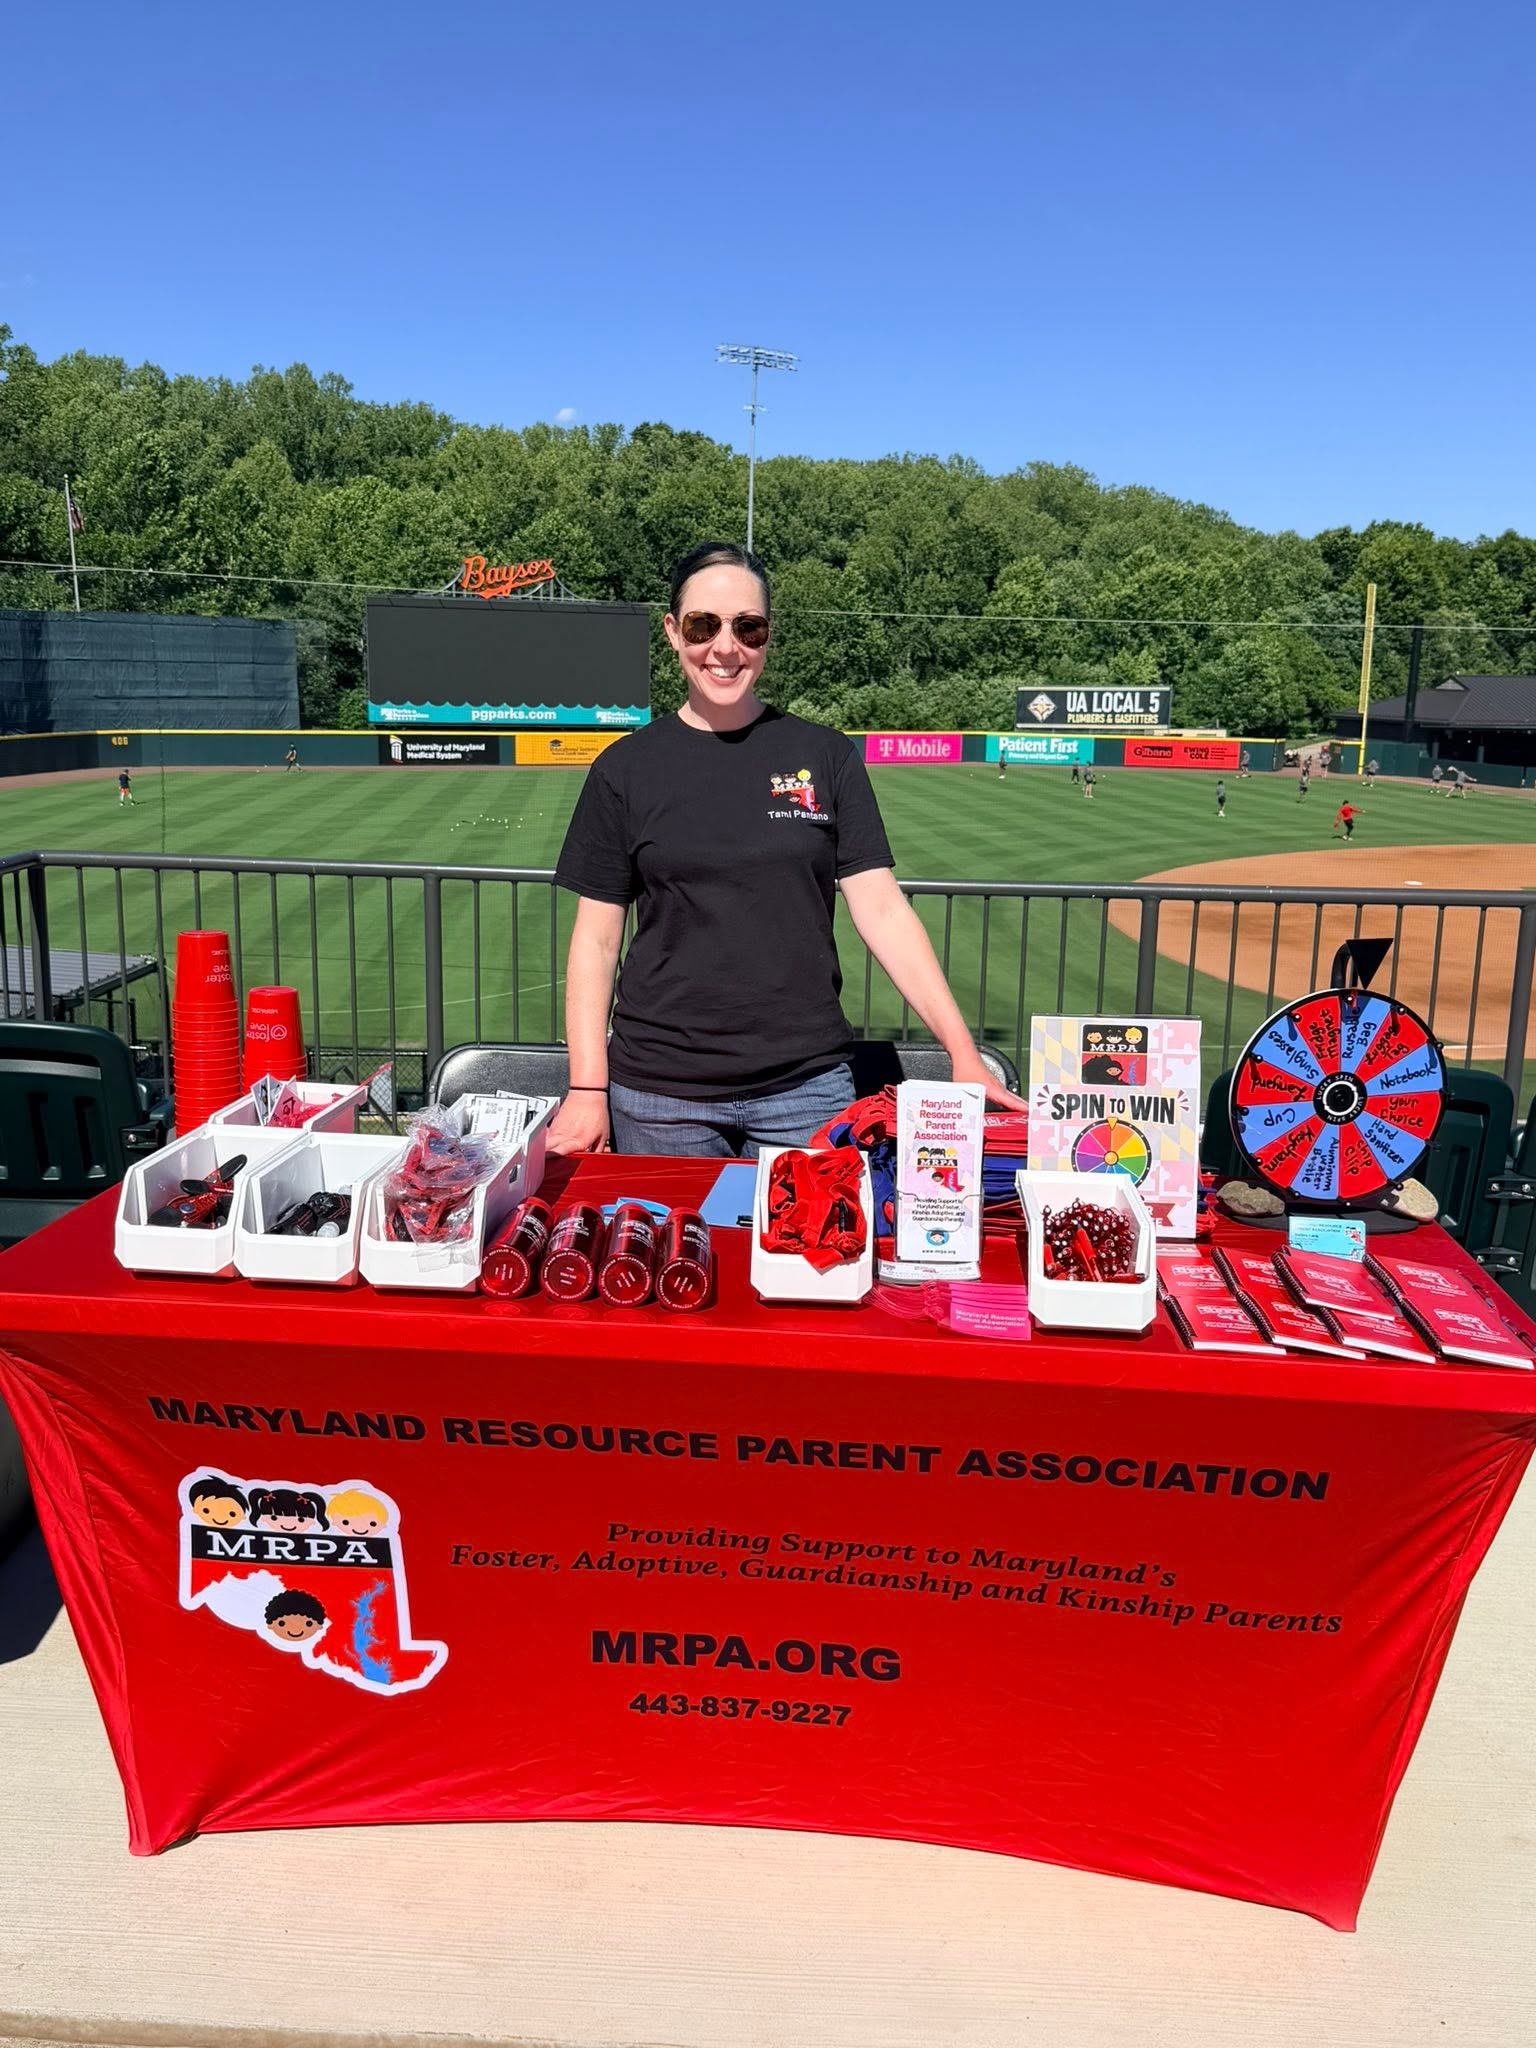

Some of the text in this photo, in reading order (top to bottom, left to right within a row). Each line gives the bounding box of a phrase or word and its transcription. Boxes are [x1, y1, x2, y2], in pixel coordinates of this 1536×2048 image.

[461, 555, 555, 599] Baysox
[1066, 692, 1160, 713] UA LOCAL 5
[471, 707, 556, 721] pgparks.com
[1067, 714, 1158, 723] PLUMBERS & GASFITTERS
[406, 743, 485, 752] University of Maryland
[880, 739, 951, 757] T Mobile
[1000, 737, 1078, 753] Patient First
[1134, 746, 1173, 758] Gilbane
[436, 752, 462, 760] System
[768, 810, 792, 819] Tami
[204, 973, 232, 983] oster
[212, 965, 230, 973] ove
[1342, 1006, 1361, 1059] Reusable
[1356, 1022, 1377, 1047] Bag
[1090, 1043, 1138, 1053] MRPA
[1268, 1031, 1319, 1079] Sunglasses
[1383, 1042, 1410, 1060] Tag
[1380, 1062, 1437, 1089] Notebook
[1316, 1074, 1354, 1100] LUCKY SPIN
[919, 1109, 963, 1119] Resource
[921, 1099, 962, 1110] Maryland
[1050, 1093, 1175, 1124] SPIN TO WIN
[925, 1120, 956, 1130] Parent
[1263, 1107, 1296, 1127] Cup
[1327, 1114, 1346, 1122] SPIN
[914, 1131, 967, 1141] Association
[1371, 1118, 1399, 1140] Hand
[1263, 1124, 1316, 1172] Keychain
[1322, 1136, 1340, 1191] Aluminum
[148, 1396, 1331, 1501] MARYLAND RESOURCE PARENT ASSOCIATION
[206, 1530, 378, 1565] MRPA
[606, 1522, 771, 1554] Providing
[779, 1532, 916, 1562] Support
[926, 1546, 960, 1567] to
[450, 1544, 1343, 1634] Foster, Adoptive, Guardianship and Kinship Parents
[591, 1629, 901, 1682] MRPA.ORG
[628, 1692, 853, 1727] 443-837-9227
